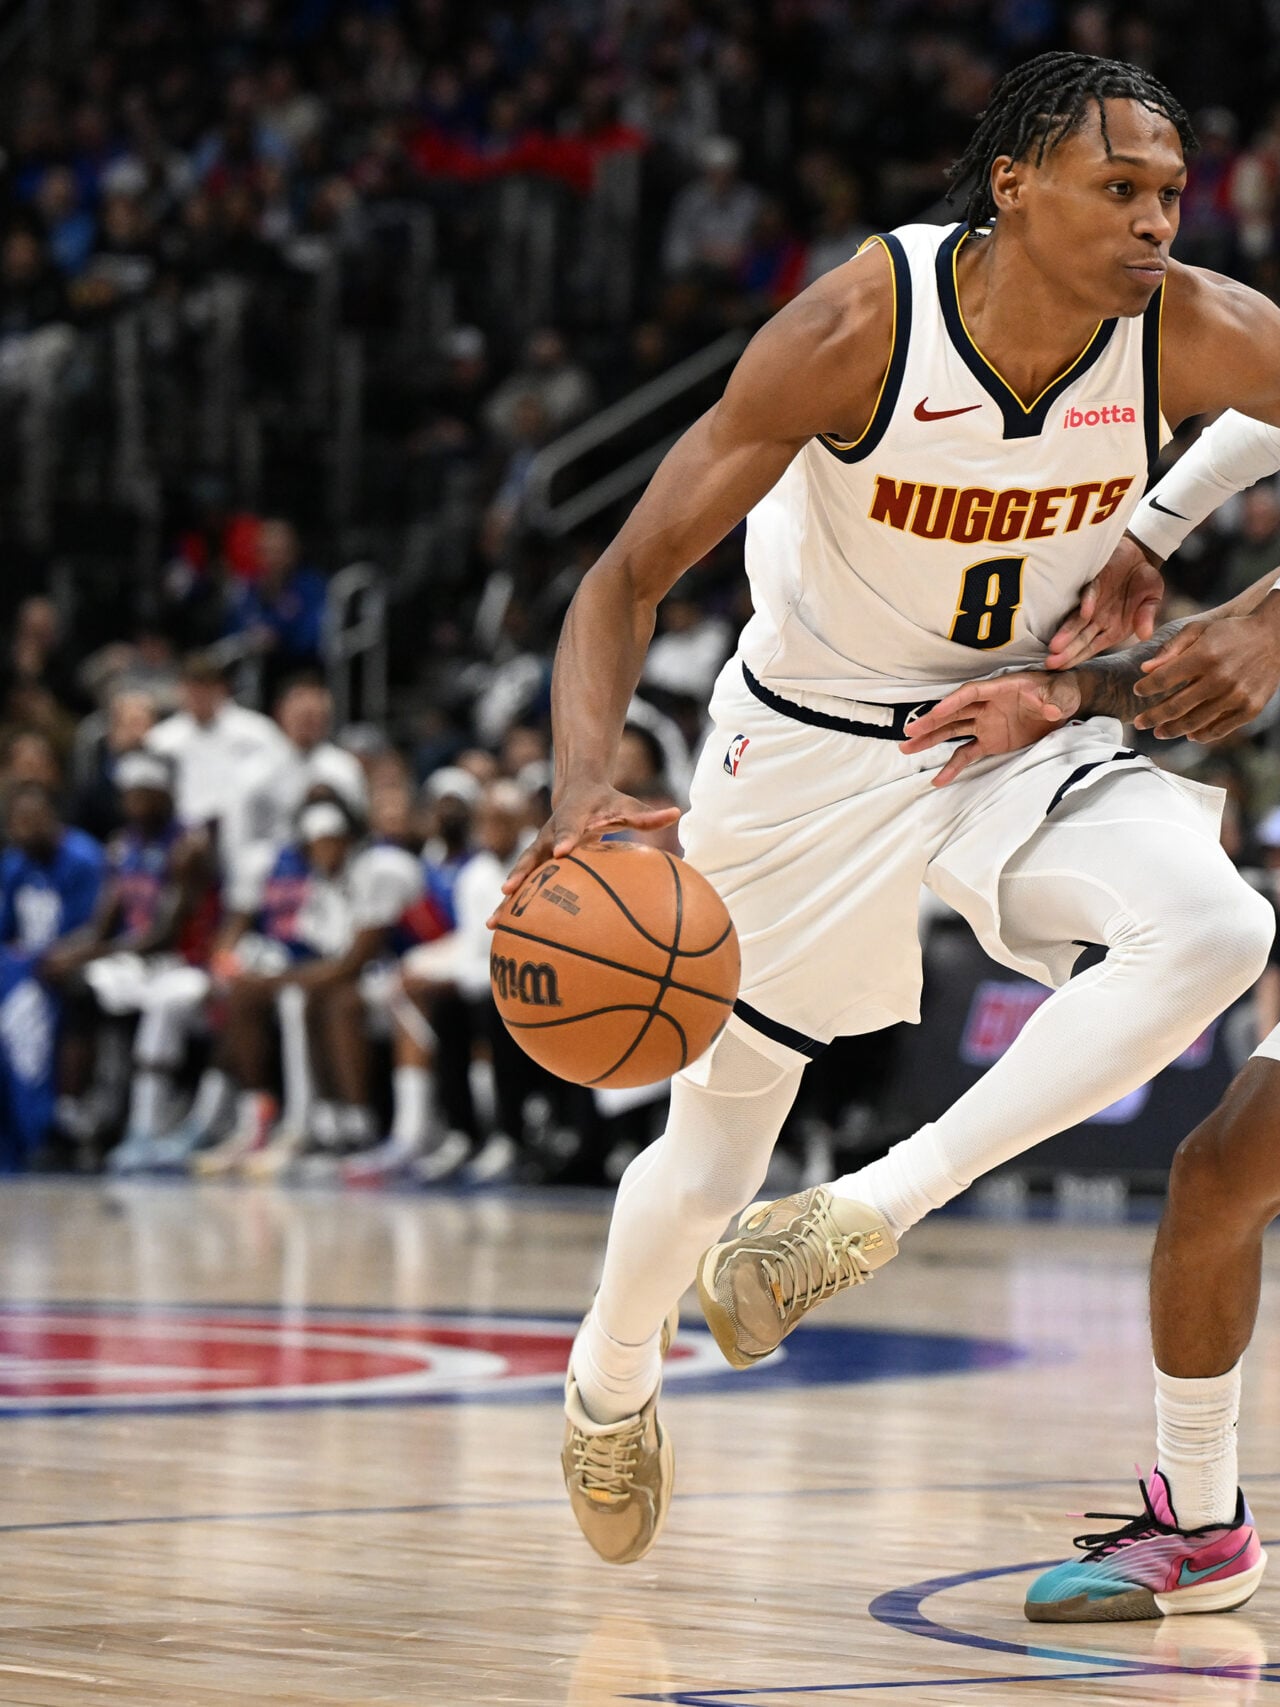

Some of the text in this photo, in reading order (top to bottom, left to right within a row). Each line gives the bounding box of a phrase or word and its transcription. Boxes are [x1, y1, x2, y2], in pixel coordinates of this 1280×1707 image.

[1063, 405, 1136, 429] ibotta
[868, 474, 1136, 543] NUGGETS
[950, 556, 1028, 650] 8
